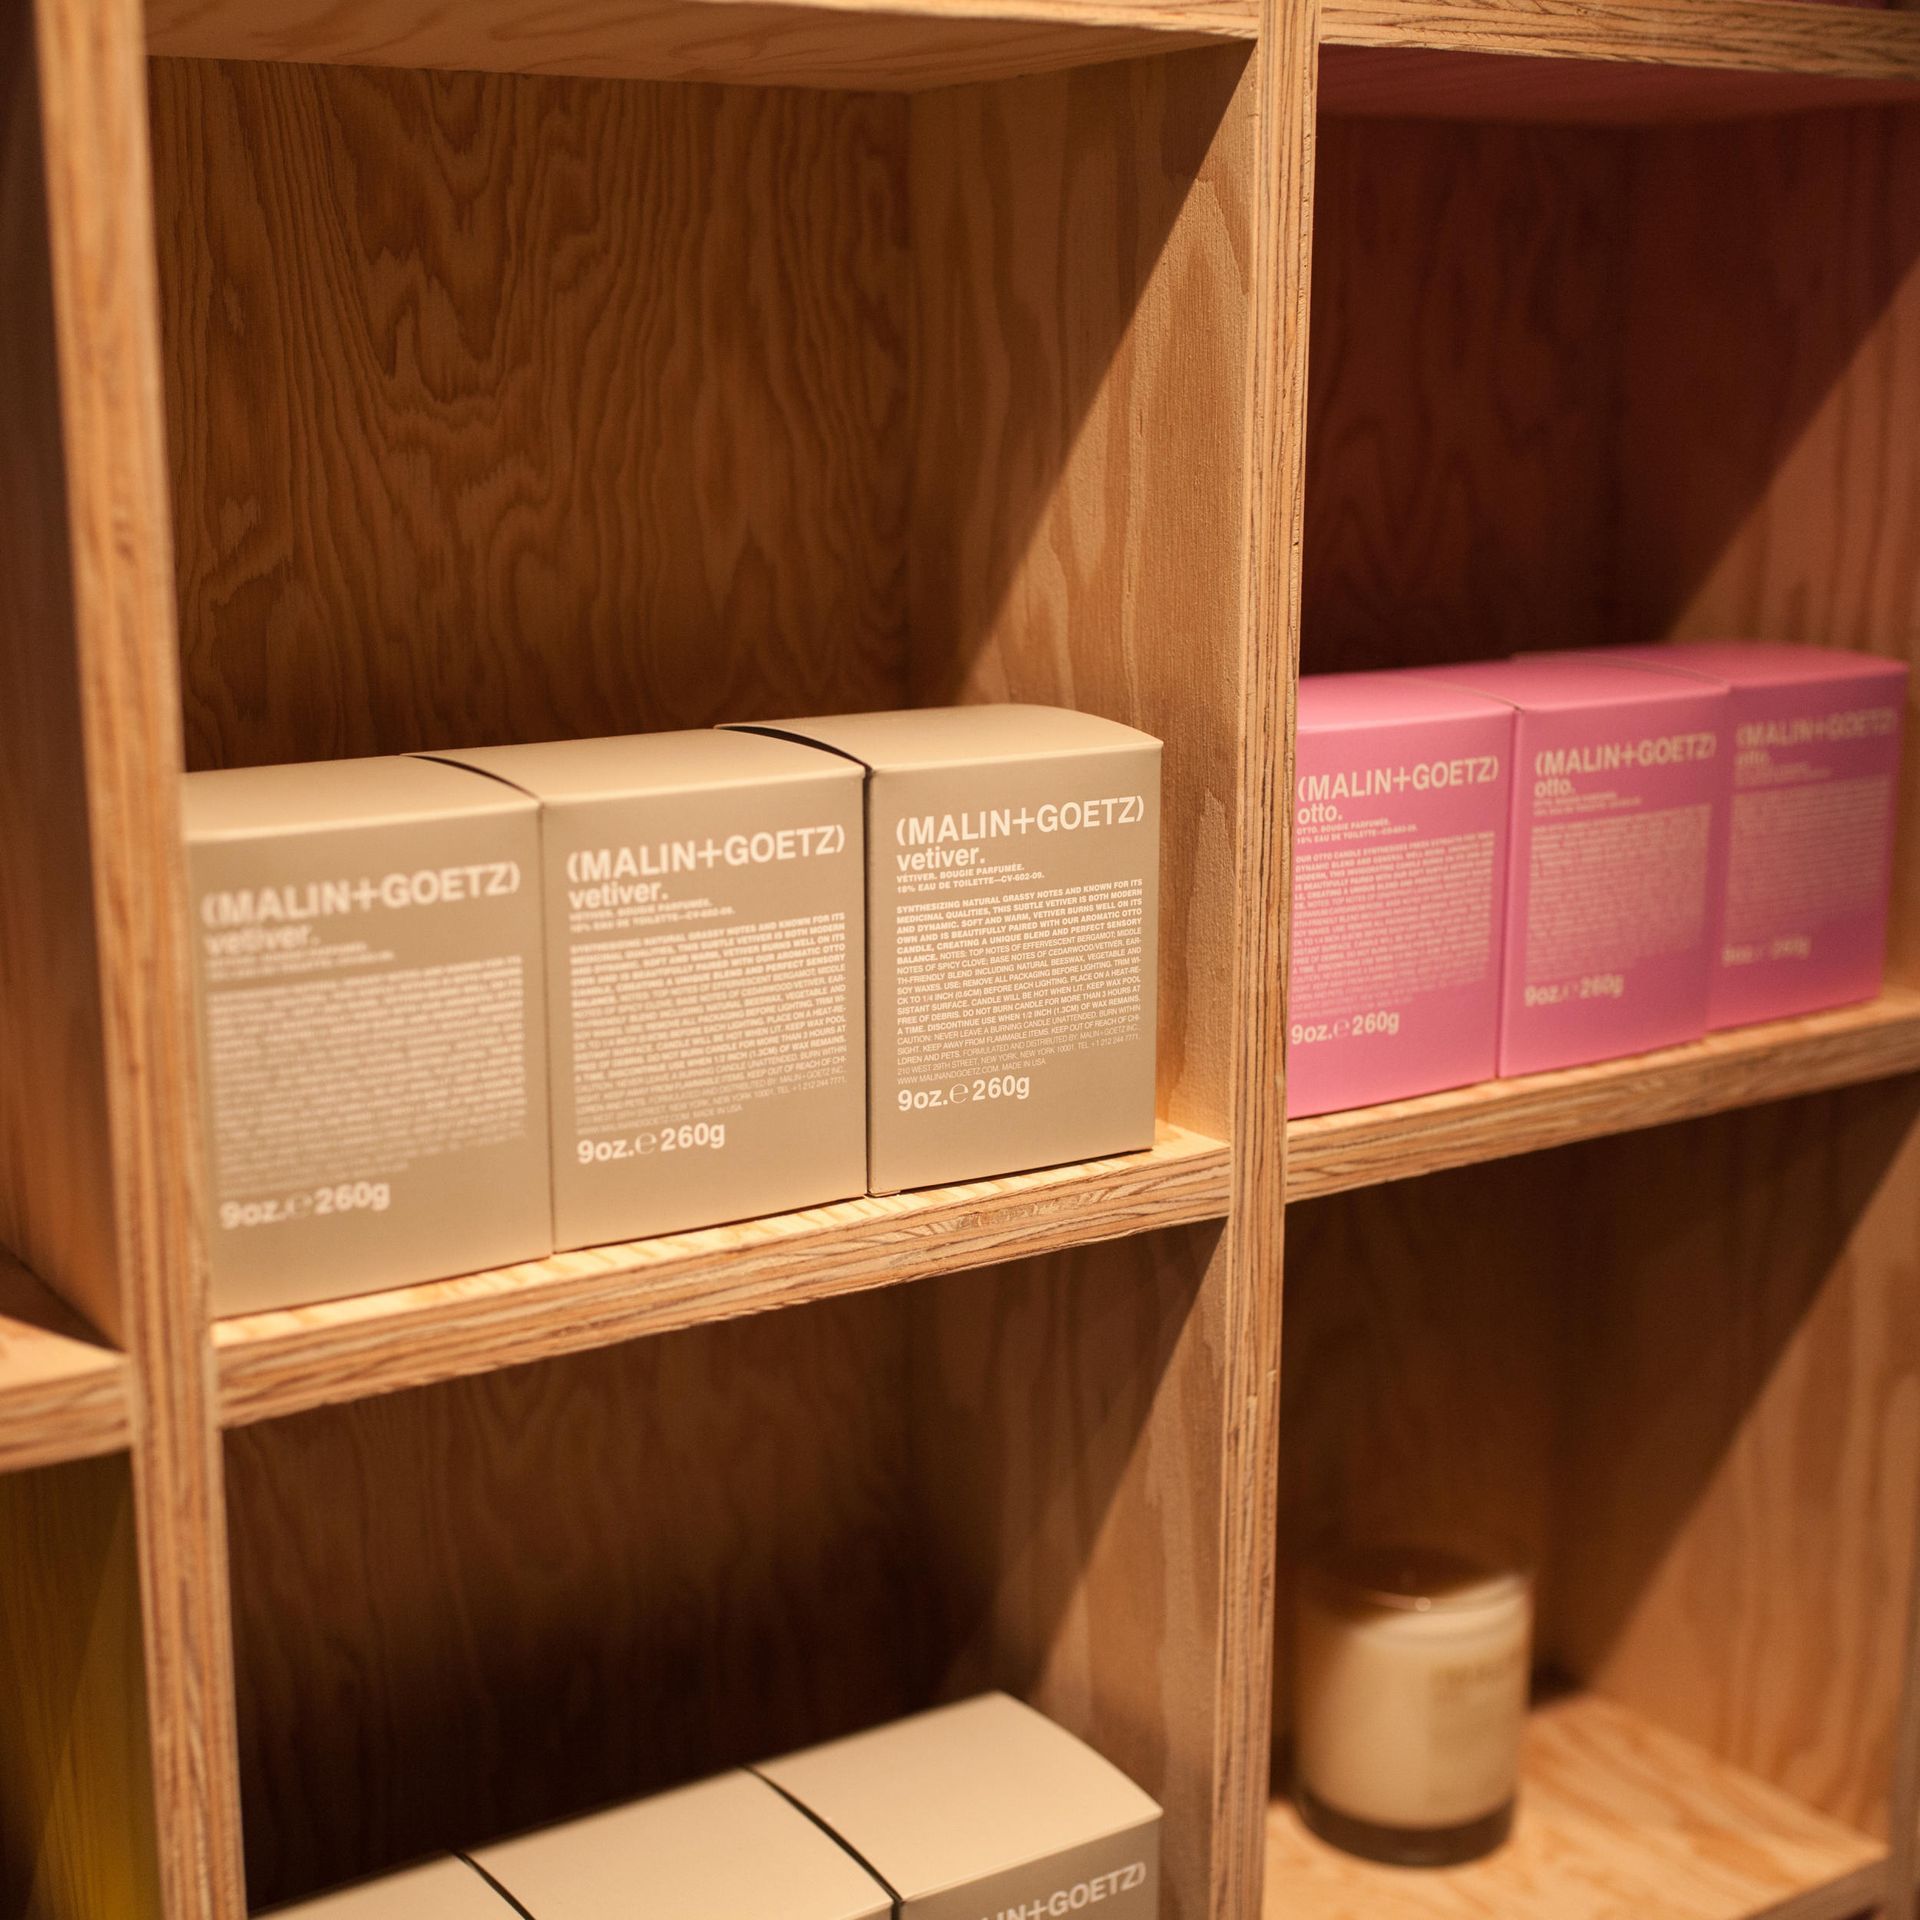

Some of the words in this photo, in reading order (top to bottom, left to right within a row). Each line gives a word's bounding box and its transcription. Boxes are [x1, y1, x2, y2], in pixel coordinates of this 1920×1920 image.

[1535, 732, 1717, 776] (MALIN+GOETZ)
[1297, 755, 1499, 803] (MALIN+GOETZ)
[1534, 778, 1576, 798] otto.
[896, 796, 1144, 846] (MALIN+GOETZ)
[1297, 802, 1343, 825] otto.
[566, 824, 846, 883] (MALIN+GOETZ)
[897, 846, 986, 872] vetiver.
[918, 882, 935, 891] EAU
[939, 881, 950, 889] DE
[940, 868, 973, 878] BOUGIE
[202, 861, 521, 928] (MALIN+GOETZ)
[568, 881, 669, 910] vetiver.
[896, 900, 960, 914] SYNTHESIZING
[962, 896, 1000, 907] NATURAL
[1002, 892, 1034, 902] GRASSY
[1037, 888, 1062, 898] NOTES
[1065, 886, 1081, 894] AND
[1083, 882, 1111, 892] KNOWN
[1113, 880, 1128, 888] FOR
[1130, 878, 1142, 886] ITS
[896, 912, 943, 924] MEDICINAL
[945, 906, 990, 918] QUALITIES,
[992, 904, 1011, 913] THIS
[1013, 900, 1043, 910] SUBTLE
[1045, 896, 1077, 906] VETIVER
[1089, 892, 1108, 901] BOTH
[1110, 888, 1142, 898] MODERN
[896, 935, 917, 944] OWN
[919, 933, 937, 942] AND
[951, 925, 1005, 938] BEAUTIFULLY
[1008, 921, 1037, 931] PAIRED
[1040, 918, 1059, 927] WITH
[1061, 916, 1078, 924] OUR
[1080, 910, 1119, 922] AROMATIC
[1121, 908, 1142, 917] OTTO
[897, 925, 915, 934] AND
[917, 920, 959, 932] DYNAMIC.
[961, 917, 983, 927] SOFT
[985, 915, 1001, 924] AND
[1004, 912, 1030, 922] WARM,
[1033, 907, 1065, 918] VETIVER
[1067, 904, 1093, 914] BURNS
[1095, 901, 1115, 910] WELL
[1130, 898, 1142, 906] ITS
[896, 943, 933, 955] CANDLE,
[936, 938, 979, 950] CREATING
[981, 937, 987, 945] A
[990, 933, 1021, 944] UNIQUE
[1023, 929, 1049, 939] BLEND
[1052, 927, 1068, 936] AND
[1070, 922, 1104, 933] PERFECT
[1106, 918, 1141, 929] SENSORY
[897, 953, 937, 965] BALANCE.
[969, 948, 983, 956] TOP
[985, 944, 1009, 954] NOTES
[1011, 943, 1020, 951] OF
[1022, 936, 1074, 949] EFFERVESCENT
[1117, 927, 1141, 937] MIDDLE
[897, 965, 922, 974] NOTES
[925, 963, 935, 971] OF
[938, 960, 959, 969] SPICY
[990, 954, 1009, 963] BASE
[1011, 951, 1034, 960] NOTES
[1036, 949, 1046, 957] OF
[1125, 937, 1141, 945] EAR-
[897, 972, 944, 984] TH-FRIENDLY
[947, 969, 972, 978] BLEND
[975, 963, 1013, 975] INCLUDING
[1016, 959, 1047, 969] NATURAL
[1087, 948, 1125, 960] VEGETABLE
[1127, 946, 1141, 955] AND
[896, 986, 911, 995] SOY
[962, 976, 992, 987] REMOVE
[995, 974, 1007, 983] ALL
[1009, 968, 1049, 980] PACKAGING
[1051, 964, 1078, 974] BEFORE
[1113, 957, 1129, 966] TRIM
[897, 1004, 929, 1015] SISTANT
[971, 995, 1000, 1006] CANDLE
[1003, 992, 1020, 1001] WILL
[1022, 990, 1031, 998] BE
[1033, 988, 1047, 997] HOT
[1049, 985, 1071, 995] WHEN
[1087, 980, 1103, 989] KEEP
[1105, 978, 1120, 987] WAX
[1122, 975, 1140, 984] POOL
[897, 1016, 917, 1025] FREE
[919, 1014, 929, 1022] OF
[962, 1008, 973, 1016] DO
[975, 1006, 990, 1014] NOT
[992, 1003, 1012, 1012] BURN
[1014, 999, 1043, 1009] CANDLE
[1044, 996, 1058, 1005] FOR
[1061, 993, 1080, 1002] MORE
[1082, 990, 1100, 999] THAN
[1107, 986, 1130, 996] HOURS
[927, 1017, 978, 1031] DISCONTINUE
[981, 1015, 996, 1023] USE
[998, 1012, 1020, 1021] WHEN
[1034, 1007, 1051, 1016] INCH
[1091, 999, 1106, 1008] WAX
